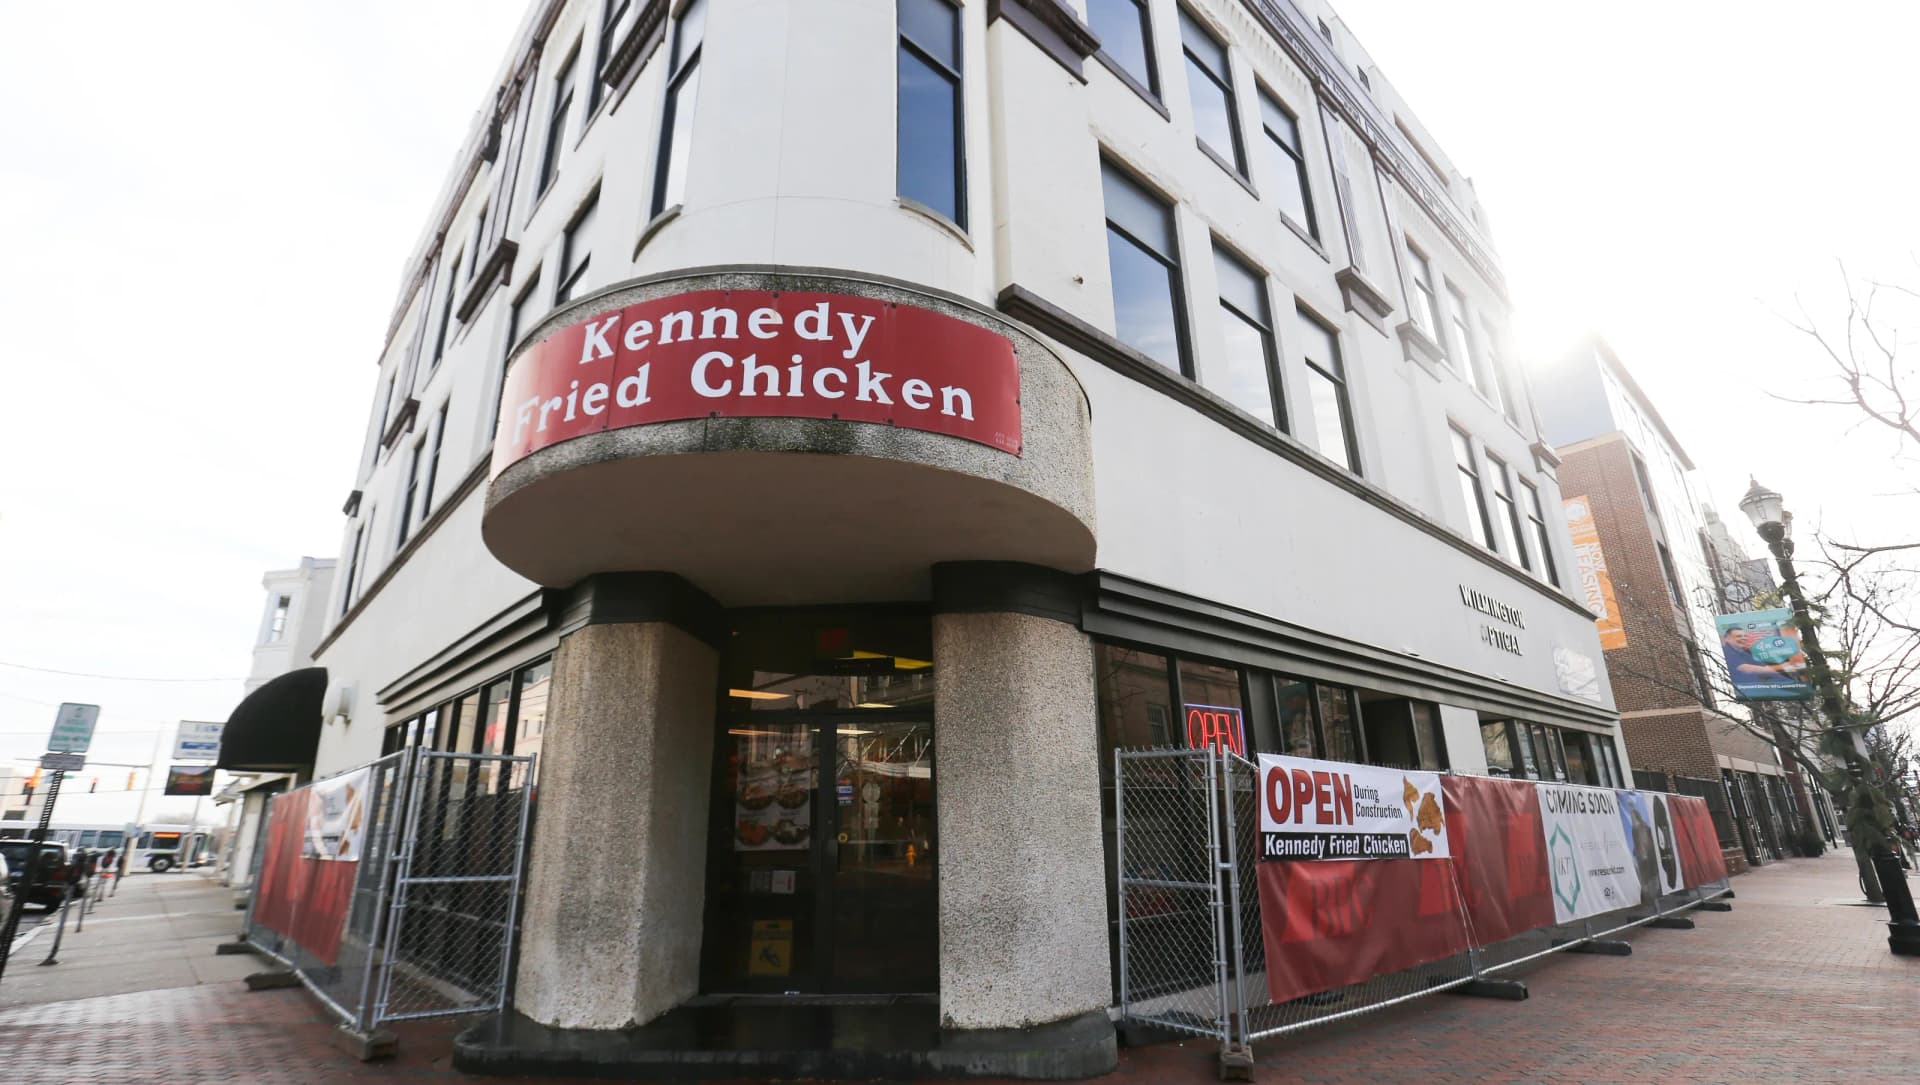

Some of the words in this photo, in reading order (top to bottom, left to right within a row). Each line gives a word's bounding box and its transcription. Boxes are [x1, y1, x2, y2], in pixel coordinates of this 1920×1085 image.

[580, 302, 875, 364] Kennedy
[512, 362, 651, 445] Fried
[690, 351, 975, 421] Chicken
[1573, 543, 1604, 616] LEASING
[1459, 584, 1526, 630] WILMINGTON
[1189, 710, 1242, 756] OPEN
[1266, 765, 1354, 825] OPEN
[1354, 784, 1380, 803] During
[1355, 802, 1403, 819] Construction
[1546, 789, 1586, 814] COMING
[1588, 791, 1615, 815] SOON
[1265, 834, 1326, 857] Kennedy
[1330, 834, 1360, 855] Fried
[1363, 834, 1407, 855] Chicken
